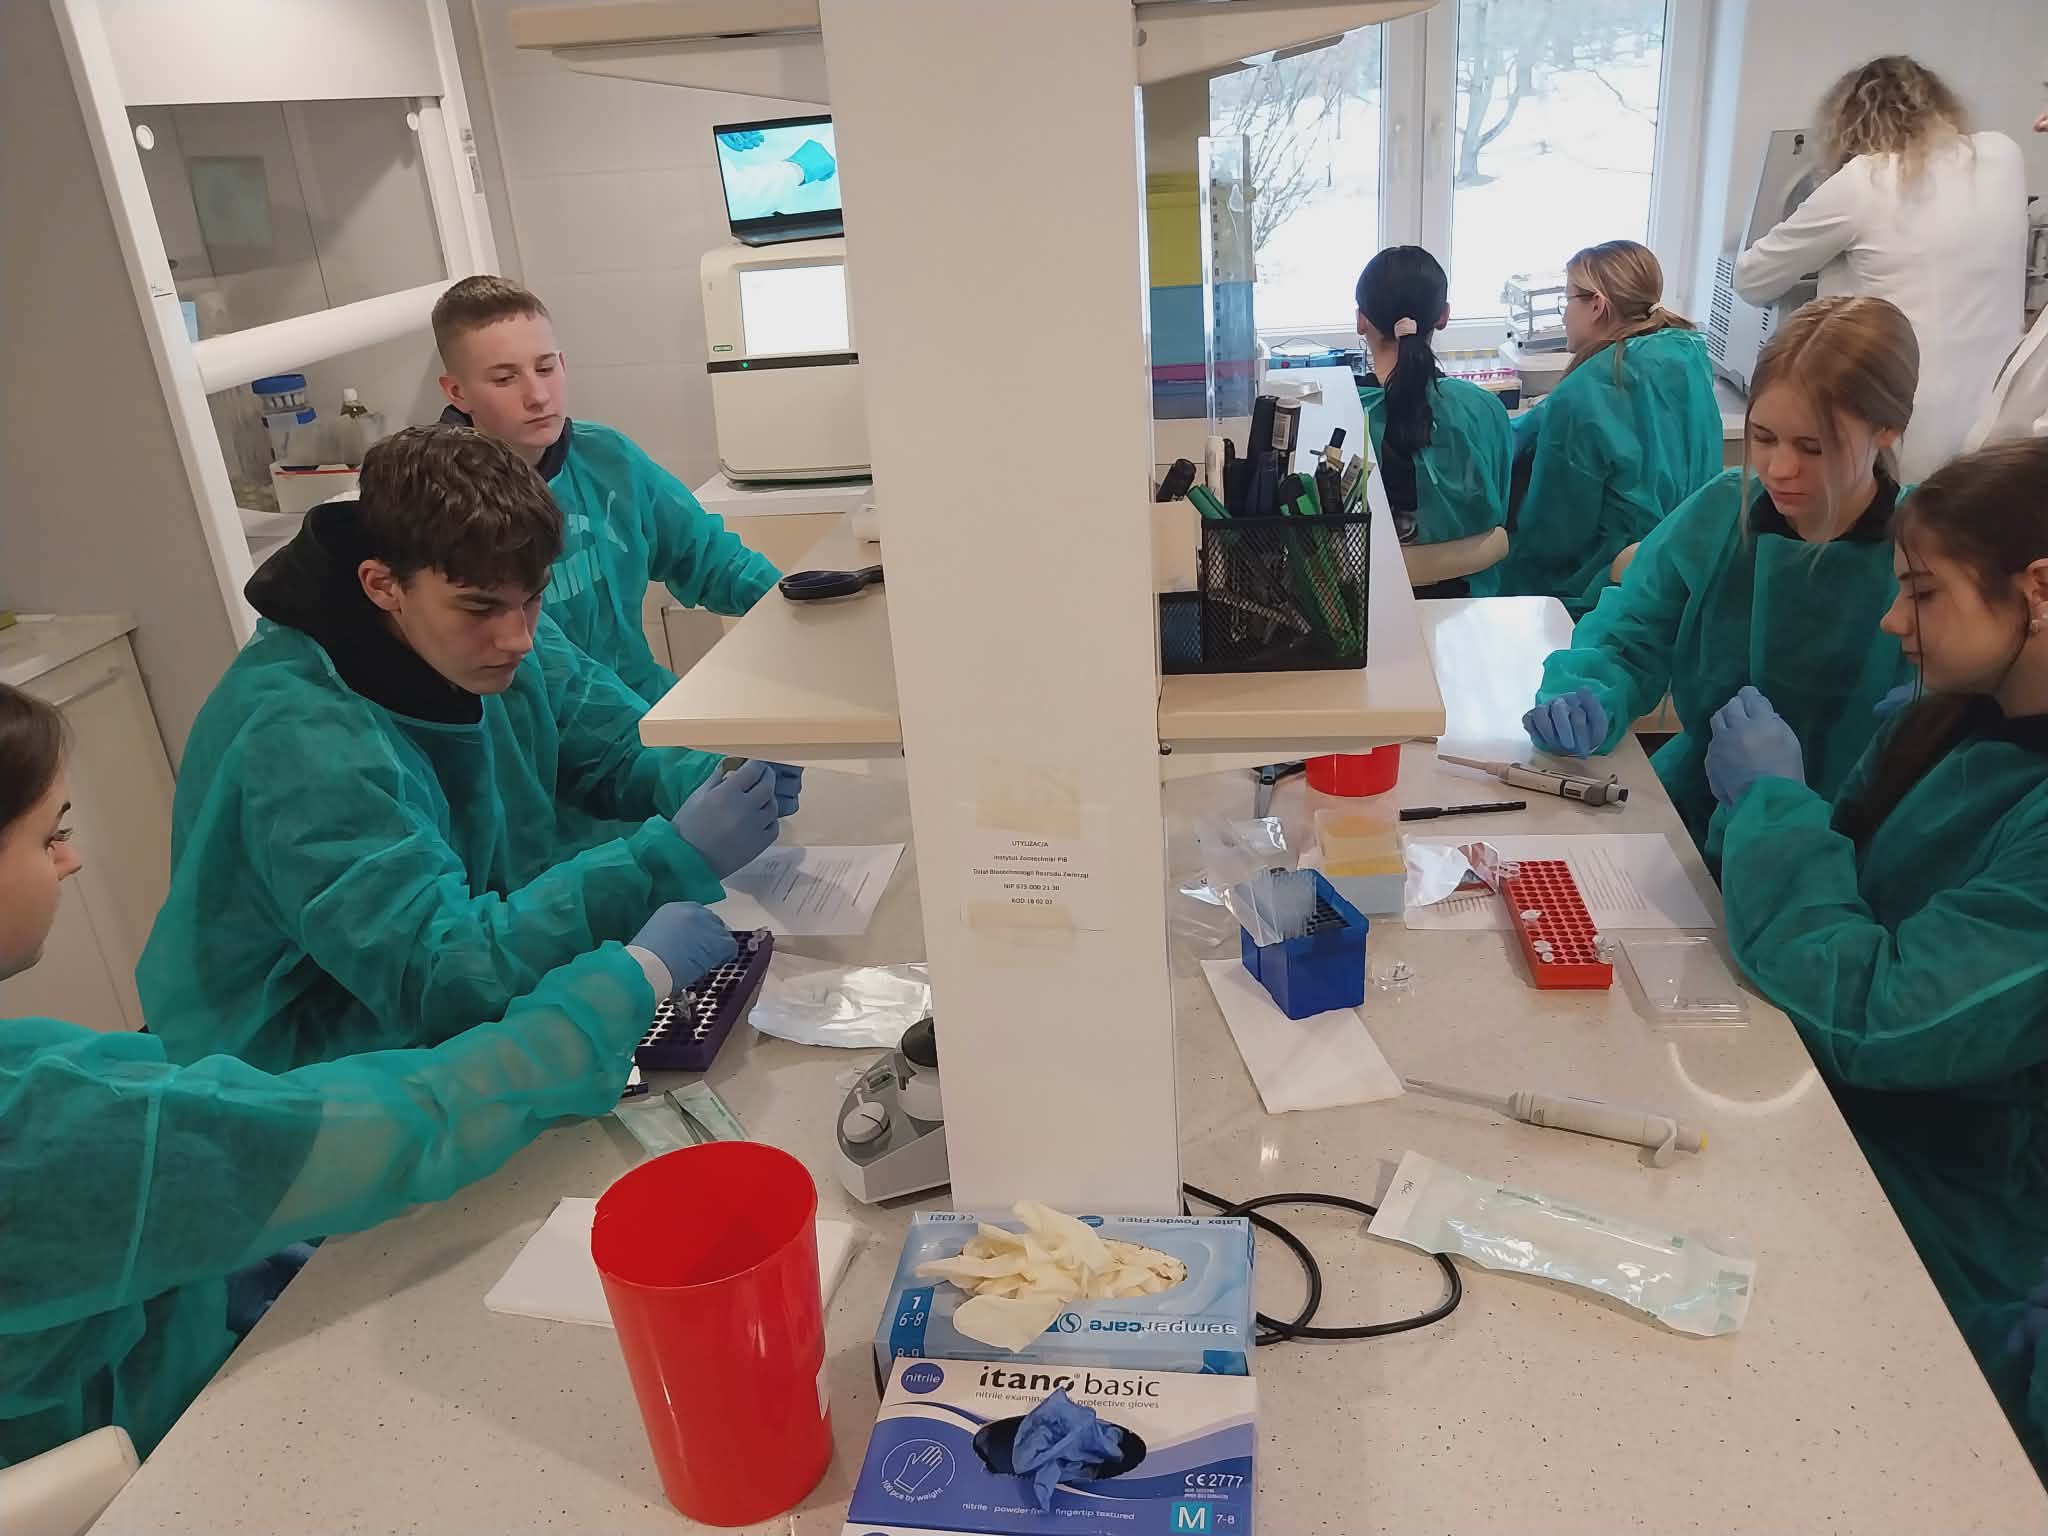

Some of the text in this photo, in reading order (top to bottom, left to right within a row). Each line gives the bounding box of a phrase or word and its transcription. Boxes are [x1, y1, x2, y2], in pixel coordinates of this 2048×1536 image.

[1208, 1218, 1242, 1226] Latex
[899, 1312, 925, 1327] 6-8
[1089, 1319, 1239, 1336] sempercare
[905, 1372, 941, 1385] nitrile
[979, 1366, 1161, 1398] itano basic
[975, 1390, 1003, 1401] nitrile
[1077, 1399, 1125, 1409] protective
[1128, 1401, 1160, 1410] gloves
[1208, 1473, 1244, 1489] 2777
[962, 1503, 988, 1512] nitrile
[1055, 1507, 1095, 1518] fingertip
[1178, 1506, 1235, 1530] M 7-8
